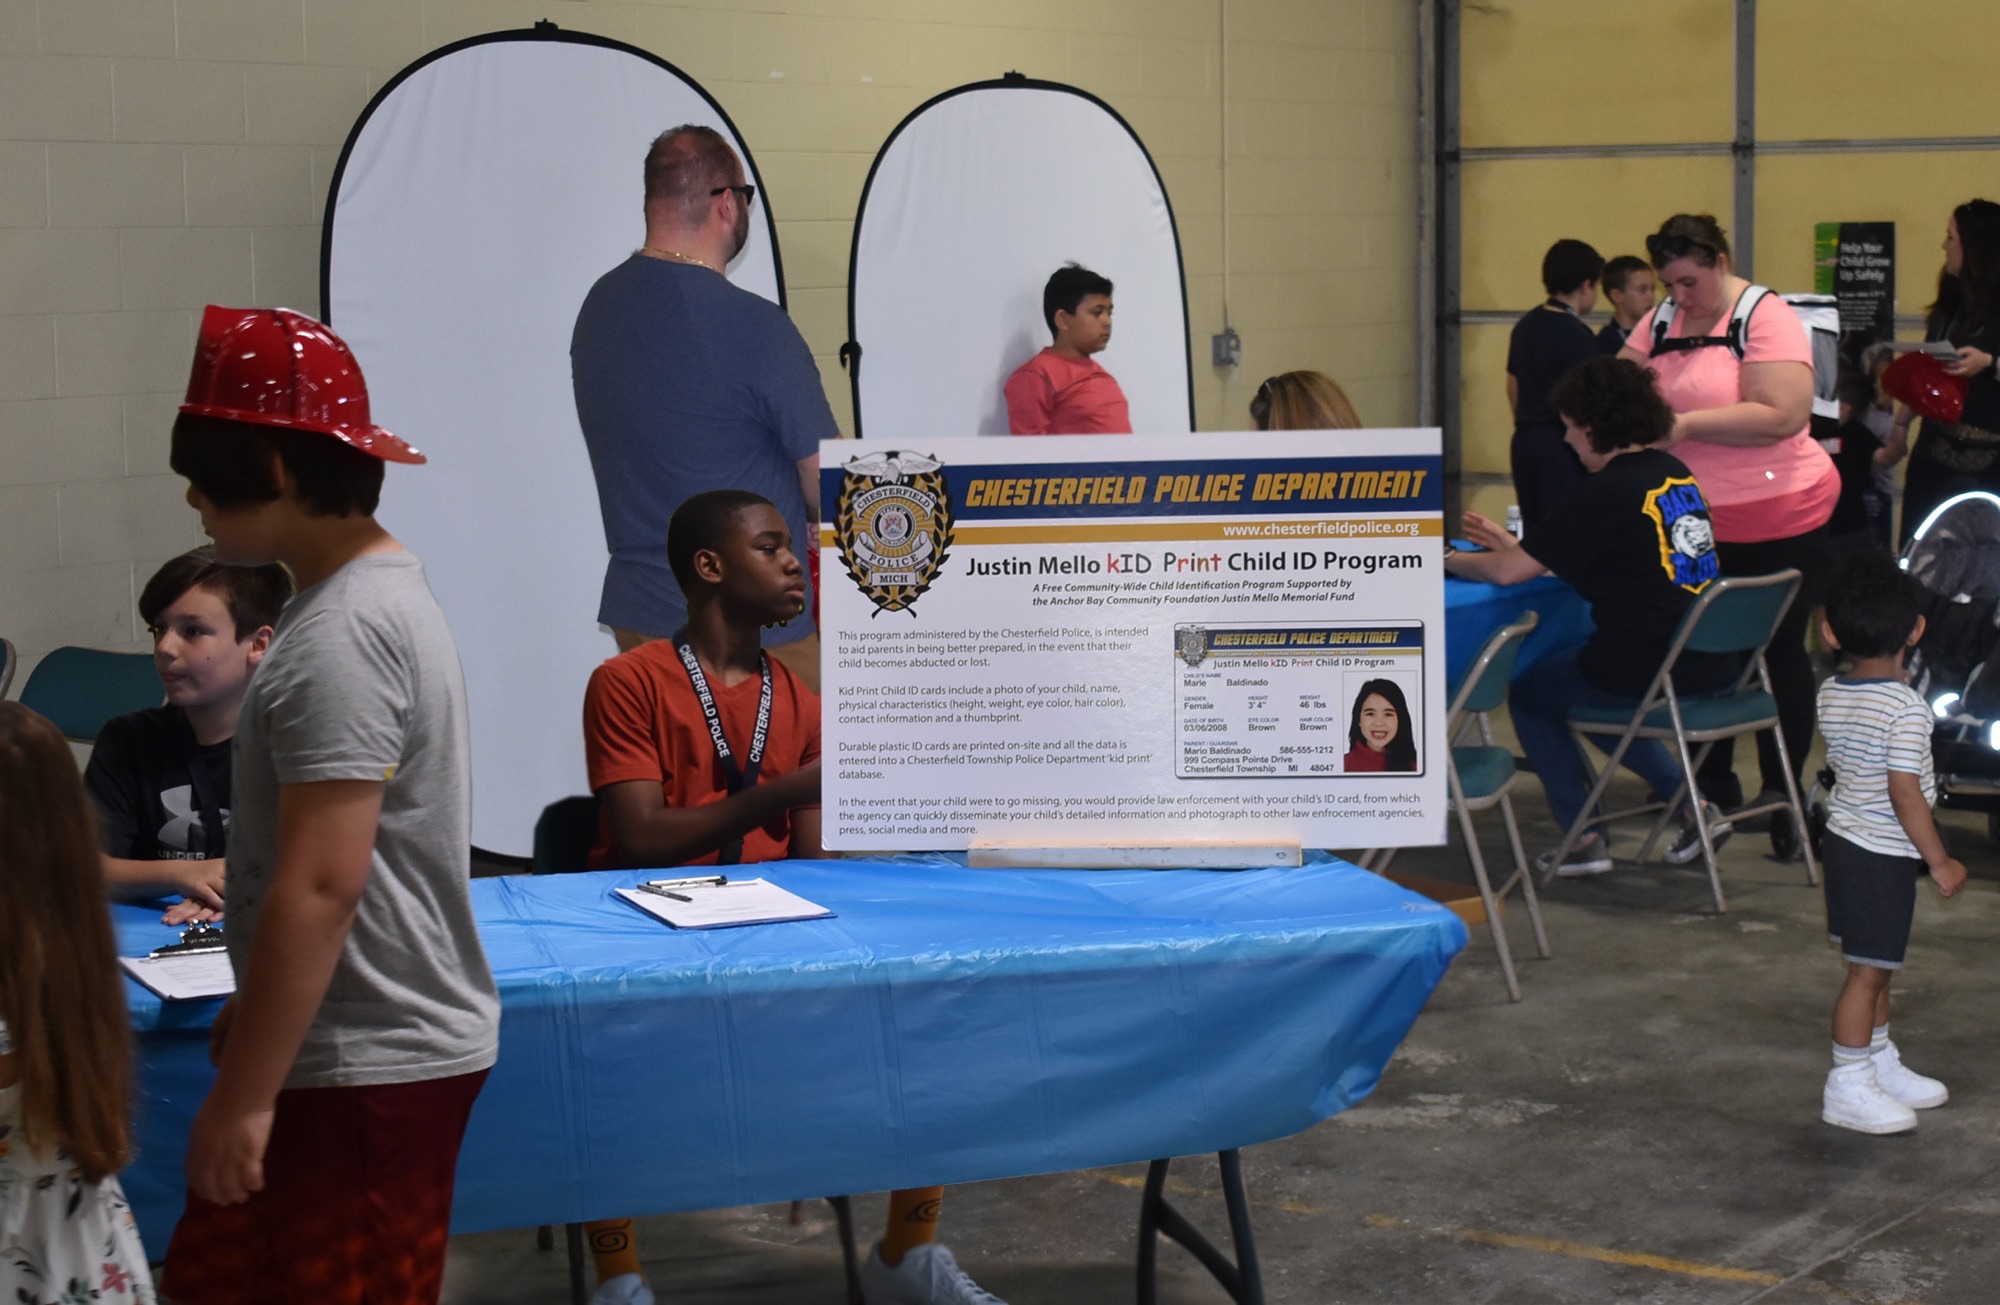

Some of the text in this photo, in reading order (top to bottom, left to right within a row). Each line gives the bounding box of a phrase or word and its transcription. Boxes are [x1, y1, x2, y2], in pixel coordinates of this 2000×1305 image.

[1840, 255, 1864, 267] Child
[965, 470, 1427, 506] CHESTERFIELD POLICE DEPARTMENT
[857, 488, 931, 509] CHESTERFIELD
[1223, 521, 1420, 538] www.chesterfieldpolice.org
[869, 555, 919, 568] POLICE
[966, 556, 1031, 575] Justin
[1039, 555, 1100, 574] Mello
[1164, 552, 1222, 572] Print
[1228, 551, 1285, 571] Child
[1293, 552, 1317, 570] ID
[1324, 551, 1422, 574] Program
[880, 575, 908, 583] MICH
[1032, 578, 1352, 593] A Free Community-Wide Child Identification Program Supported by
[1032, 592, 1355, 606] the Anchor Bay Community Foundation Justin Mello Memorial Fund
[838, 631, 858, 640] This
[860, 632, 901, 642] program
[903, 629, 966, 639] administered
[968, 629, 981, 640] by
[983, 629, 999, 638] the
[1001, 627, 1059, 638] Chesterfield
[1095, 628, 1102, 636] is
[1104, 626, 1148, 636] intended
[1213, 631, 1399, 645] CHESTERFIELD POLICE DEPARTMENT
[838, 658, 862, 668] child
[864, 658, 907, 668] becomes
[909, 657, 955, 667] abducted
[970, 657, 990, 666] lost.
[1213, 659, 1240, 669] Justin
[1243, 659, 1269, 667] Mello
[1291, 658, 1313, 666] Print
[1315, 658, 1339, 666] Child
[1342, 658, 1352, 666] ID
[1354, 658, 1394, 668] Program
[1226, 678, 1268, 686] Baldinado
[839, 686, 854, 696] Kid
[856, 686, 879, 695] Print
[881, 686, 905, 695] Child
[908, 686, 919, 695] ID
[920, 685, 946, 695] cards
[948, 685, 984, 694] include
[994, 684, 1024, 696] photo
[1025, 683, 1036, 694] of
[1037, 686, 1060, 696] your
[1062, 683, 1088, 694] child,
[679, 644, 730, 758] CHESTERFIELD POLICE
[839, 700, 877, 712] physical
[879, 700, 947, 709] characteristics
[949, 699, 986, 710] (height,
[988, 698, 1024, 710] weight,
[1026, 700, 1044, 709] eye
[1074, 697, 1093, 707] hair
[749, 686, 771, 763] CHESTERFIELD
[1184, 723, 1227, 731] 03/06/2008
[1248, 723, 1276, 731] Brown
[839, 742, 877, 751] Durable
[879, 741, 910, 752] plastic
[912, 741, 923, 751] ID
[924, 741, 950, 750] cards
[969, 740, 1005, 752] printed
[1007, 740, 1040, 750] on-site
[1042, 740, 1061, 749] and
[1063, 740, 1075, 749] all
[1077, 740, 1093, 749] the
[1095, 740, 1117, 749] data
[1119, 740, 1127, 748] is
[1279, 746, 1334, 754] 586-555-1212
[838, 755, 876, 765] entered
[878, 756, 897, 765] into
[907, 754, 965, 764] Chesterfield
[966, 754, 1013, 765] Township
[1015, 754, 1044, 764] Police
[1046, 754, 1105, 765] Department
[1184, 755, 1293, 764] 999 Compass Pointe Drive
[838, 769, 884, 779] database.
[1184, 765, 1234, 773] Chesterfield
[1236, 765, 1276, 773] Township
[1309, 764, 1334, 772] 48047
[839, 811, 855, 820] the
[857, 813, 892, 822] agency
[913, 810, 948, 822] quickly
[949, 810, 1007, 820] disseminate
[1009, 812, 1032, 821] your
[1065, 809, 1105, 819] detailed
[1108, 809, 1165, 819] information
[1167, 809, 1186, 818] and
[1189, 808, 1248, 820] photograph
[1250, 810, 1261, 818] to
[1263, 808, 1290, 818] other
[1292, 808, 1310, 818] law
[1311, 808, 1376, 818] enfrocement
[839, 824, 977, 836] press, social media and more.
[158, 850, 206, 860] UNDER
